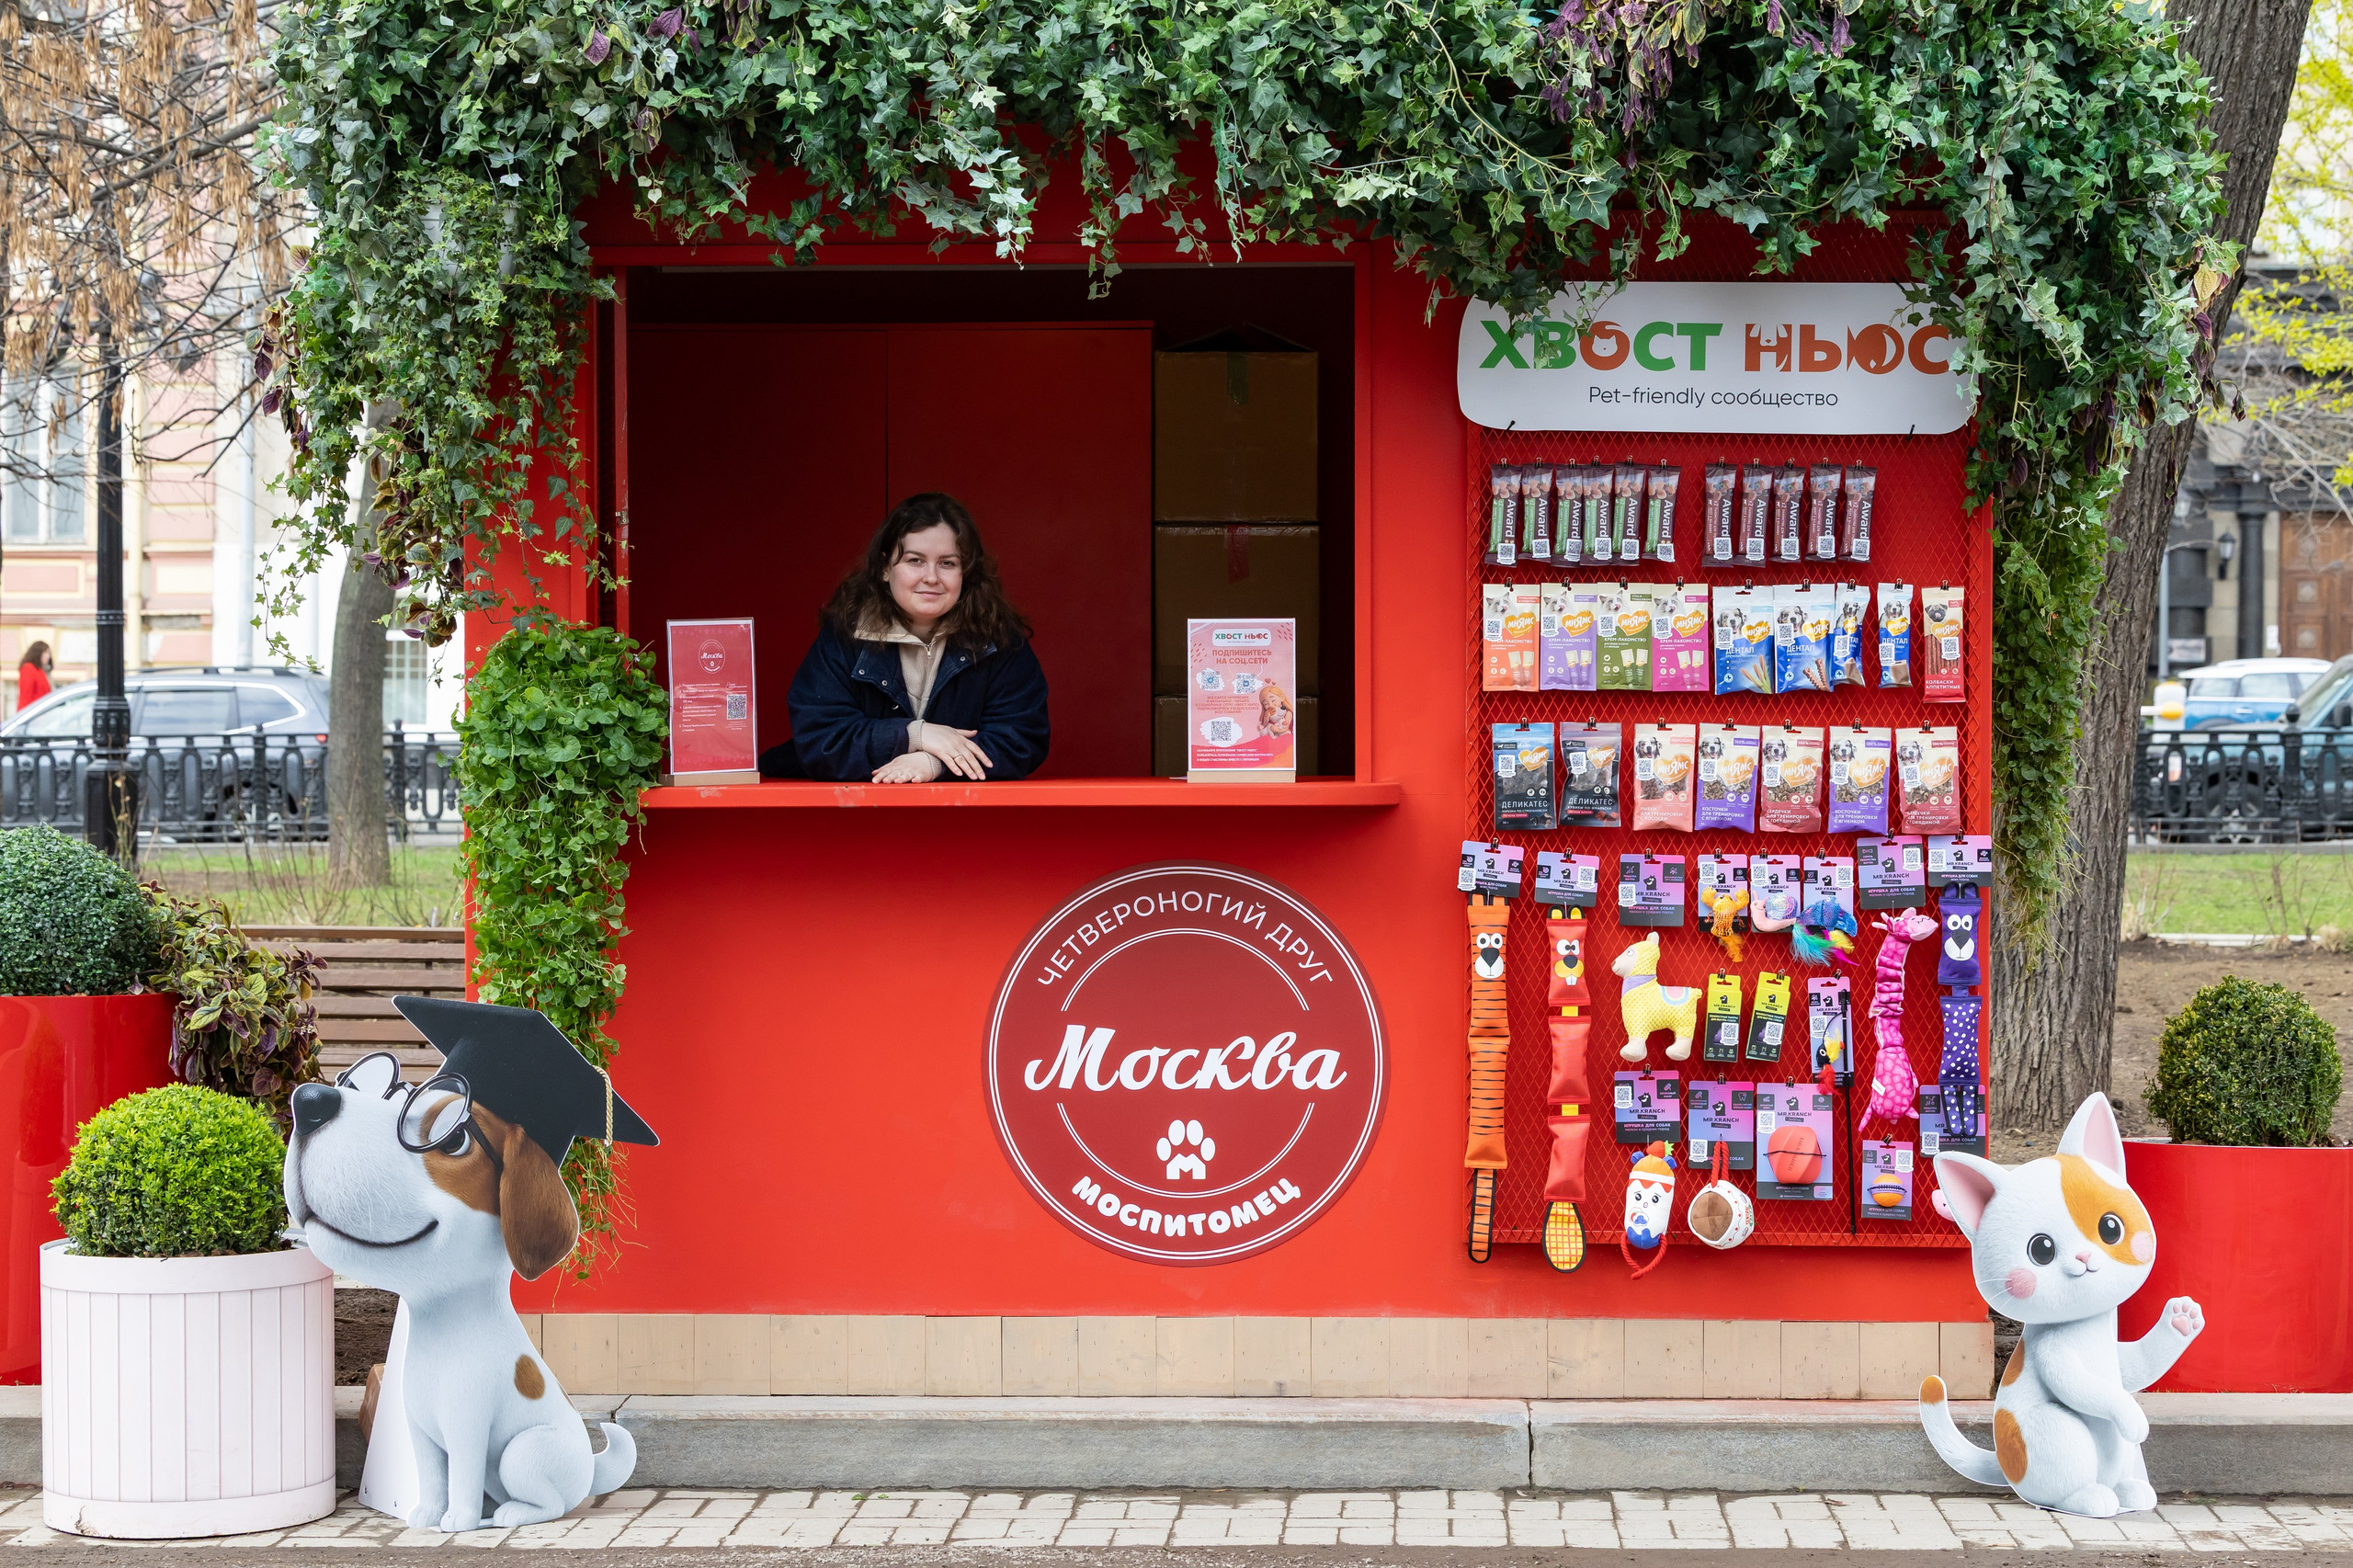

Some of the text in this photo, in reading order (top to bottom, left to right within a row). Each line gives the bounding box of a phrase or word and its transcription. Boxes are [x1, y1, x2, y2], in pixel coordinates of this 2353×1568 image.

[1479, 320, 1951, 375] ХВОСТ НЬЮС
[1588, 386, 1838, 408] Pet-friendly сообщество
[1505, 499, 1517, 538] Award
[1537, 497, 1548, 537] Award
[1571, 499, 1582, 539] Award
[1599, 499, 1610, 537] Award
[1626, 497, 1639, 537] Award
[1661, 498, 1674, 539] Award
[1722, 498, 1732, 537] Award
[1754, 498, 1767, 537] Award
[1859, 500, 1872, 540] Award
[1211, 649, 1272, 657] ПОДПИШИТЕСЬ
[1725, 646, 1755, 654] ДЕНТАЛ
[1786, 644, 1814, 653] ДЕНТАЛ
[1784, 763, 1816, 778] МНЯМС
[1502, 800, 1549, 809] ДЕЛИКАТЕС
[1568, 798, 1614, 806] ДЕЛИКАТЕС
[1037, 890, 1334, 986] ЧЕТВЕРОНОГИЙ ДРУГ
[1024, 1023, 1347, 1092] Москва
[1072, 1176, 1302, 1237] МОСПИТОМЕЦ
